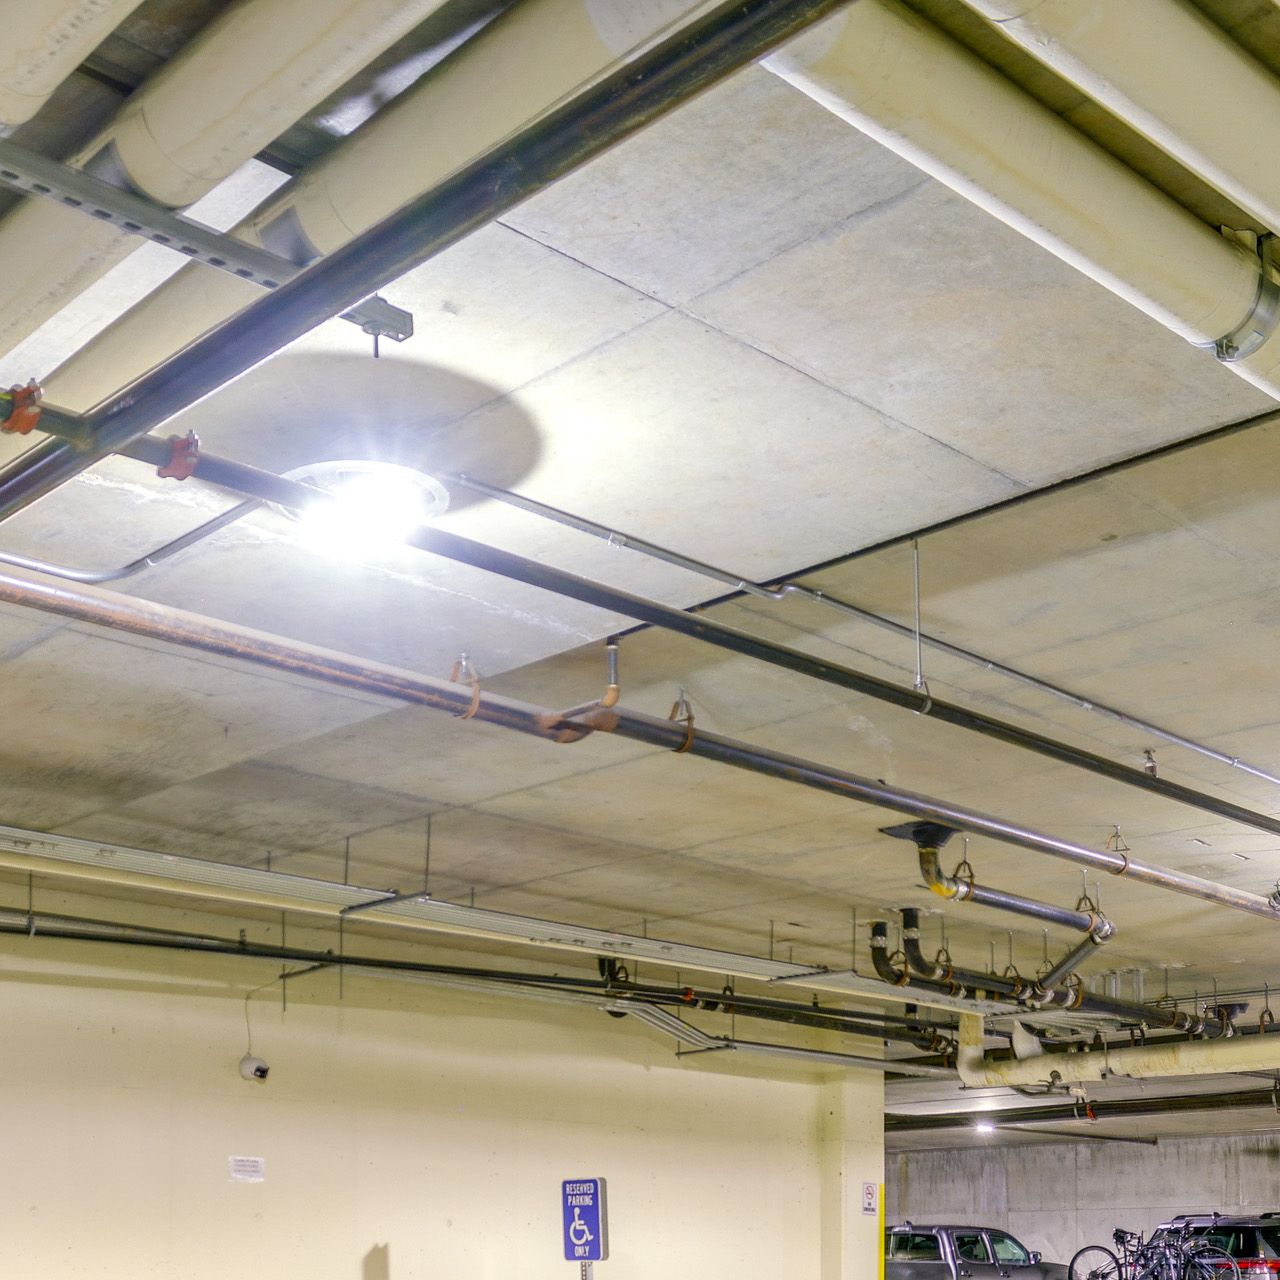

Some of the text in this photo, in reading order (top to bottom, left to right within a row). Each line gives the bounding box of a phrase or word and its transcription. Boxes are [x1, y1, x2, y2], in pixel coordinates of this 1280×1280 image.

[566, 1183, 594, 1195] RESERVED
[568, 1195, 593, 1206] PARKING
[574, 1246, 590, 1257] ONLY
